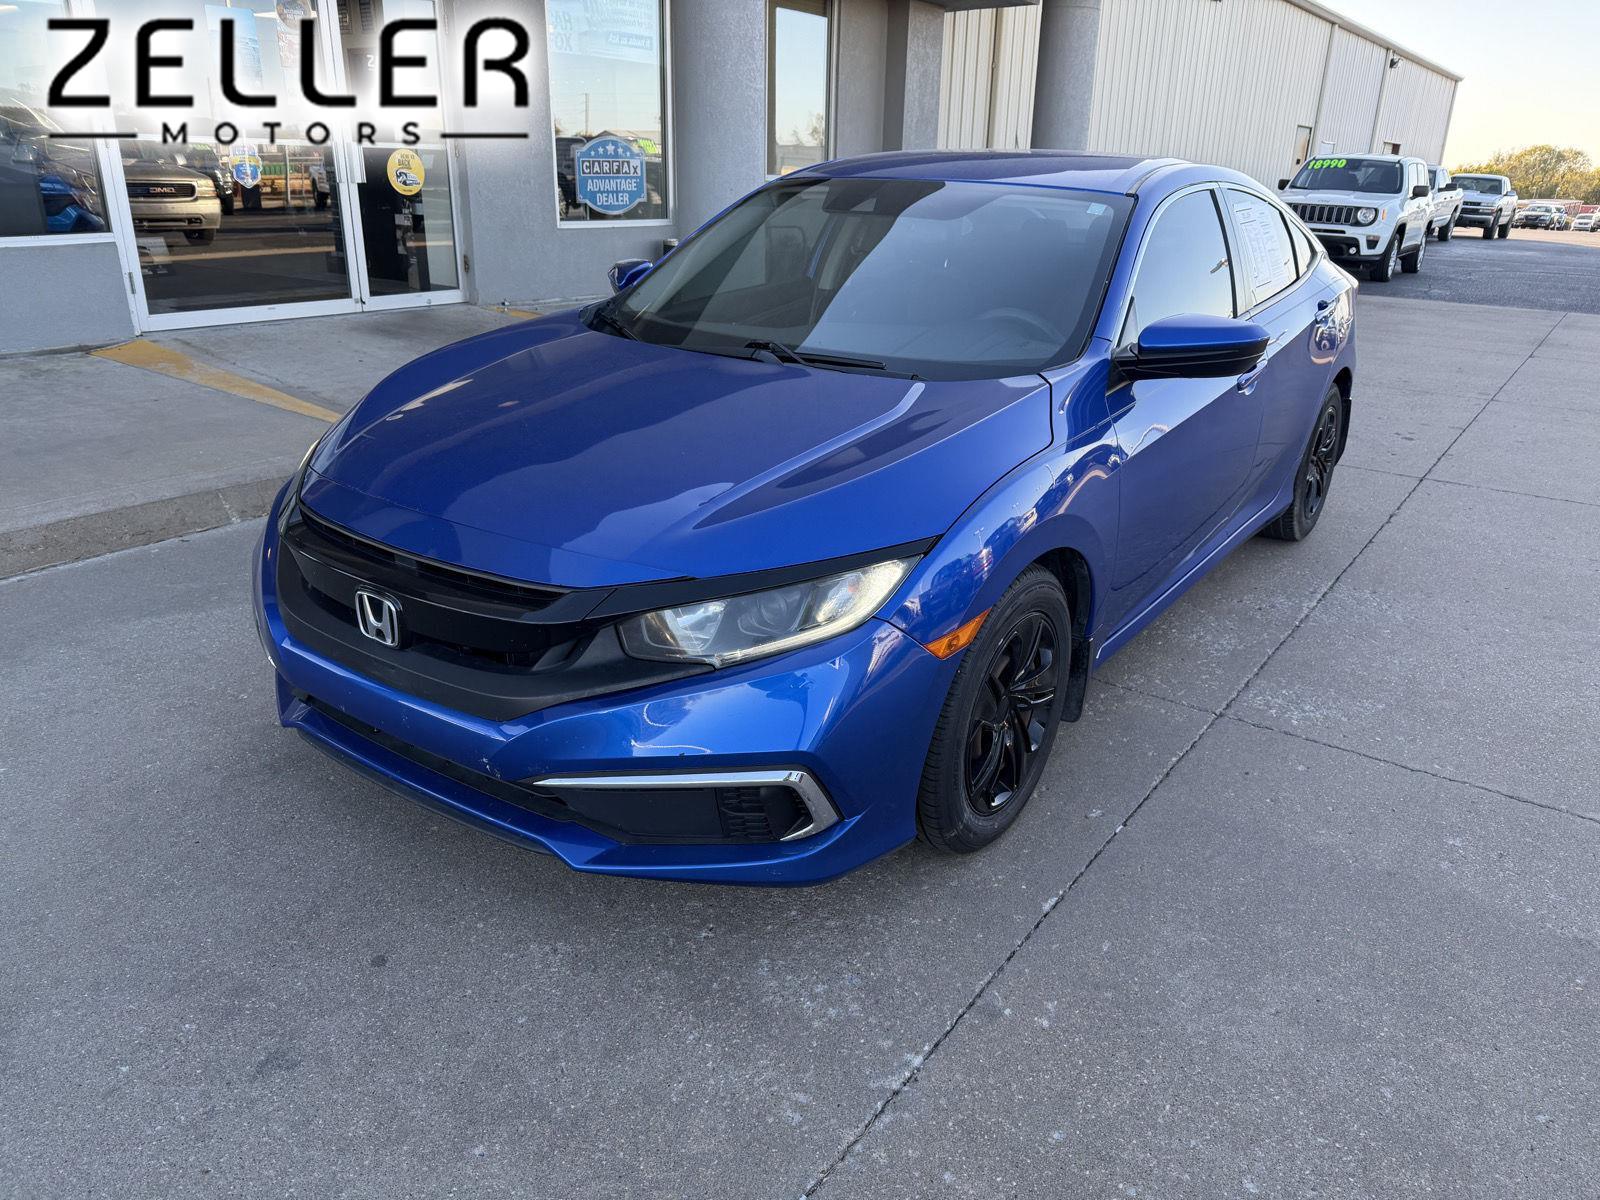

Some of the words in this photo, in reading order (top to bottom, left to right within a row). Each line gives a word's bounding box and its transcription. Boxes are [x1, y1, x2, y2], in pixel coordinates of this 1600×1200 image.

[582, 161, 639, 175] CARFAX
[1308, 159, 1347, 169] 18990
[587, 178, 638, 191] ADVANTAGE
[596, 192, 630, 205] DEALER
